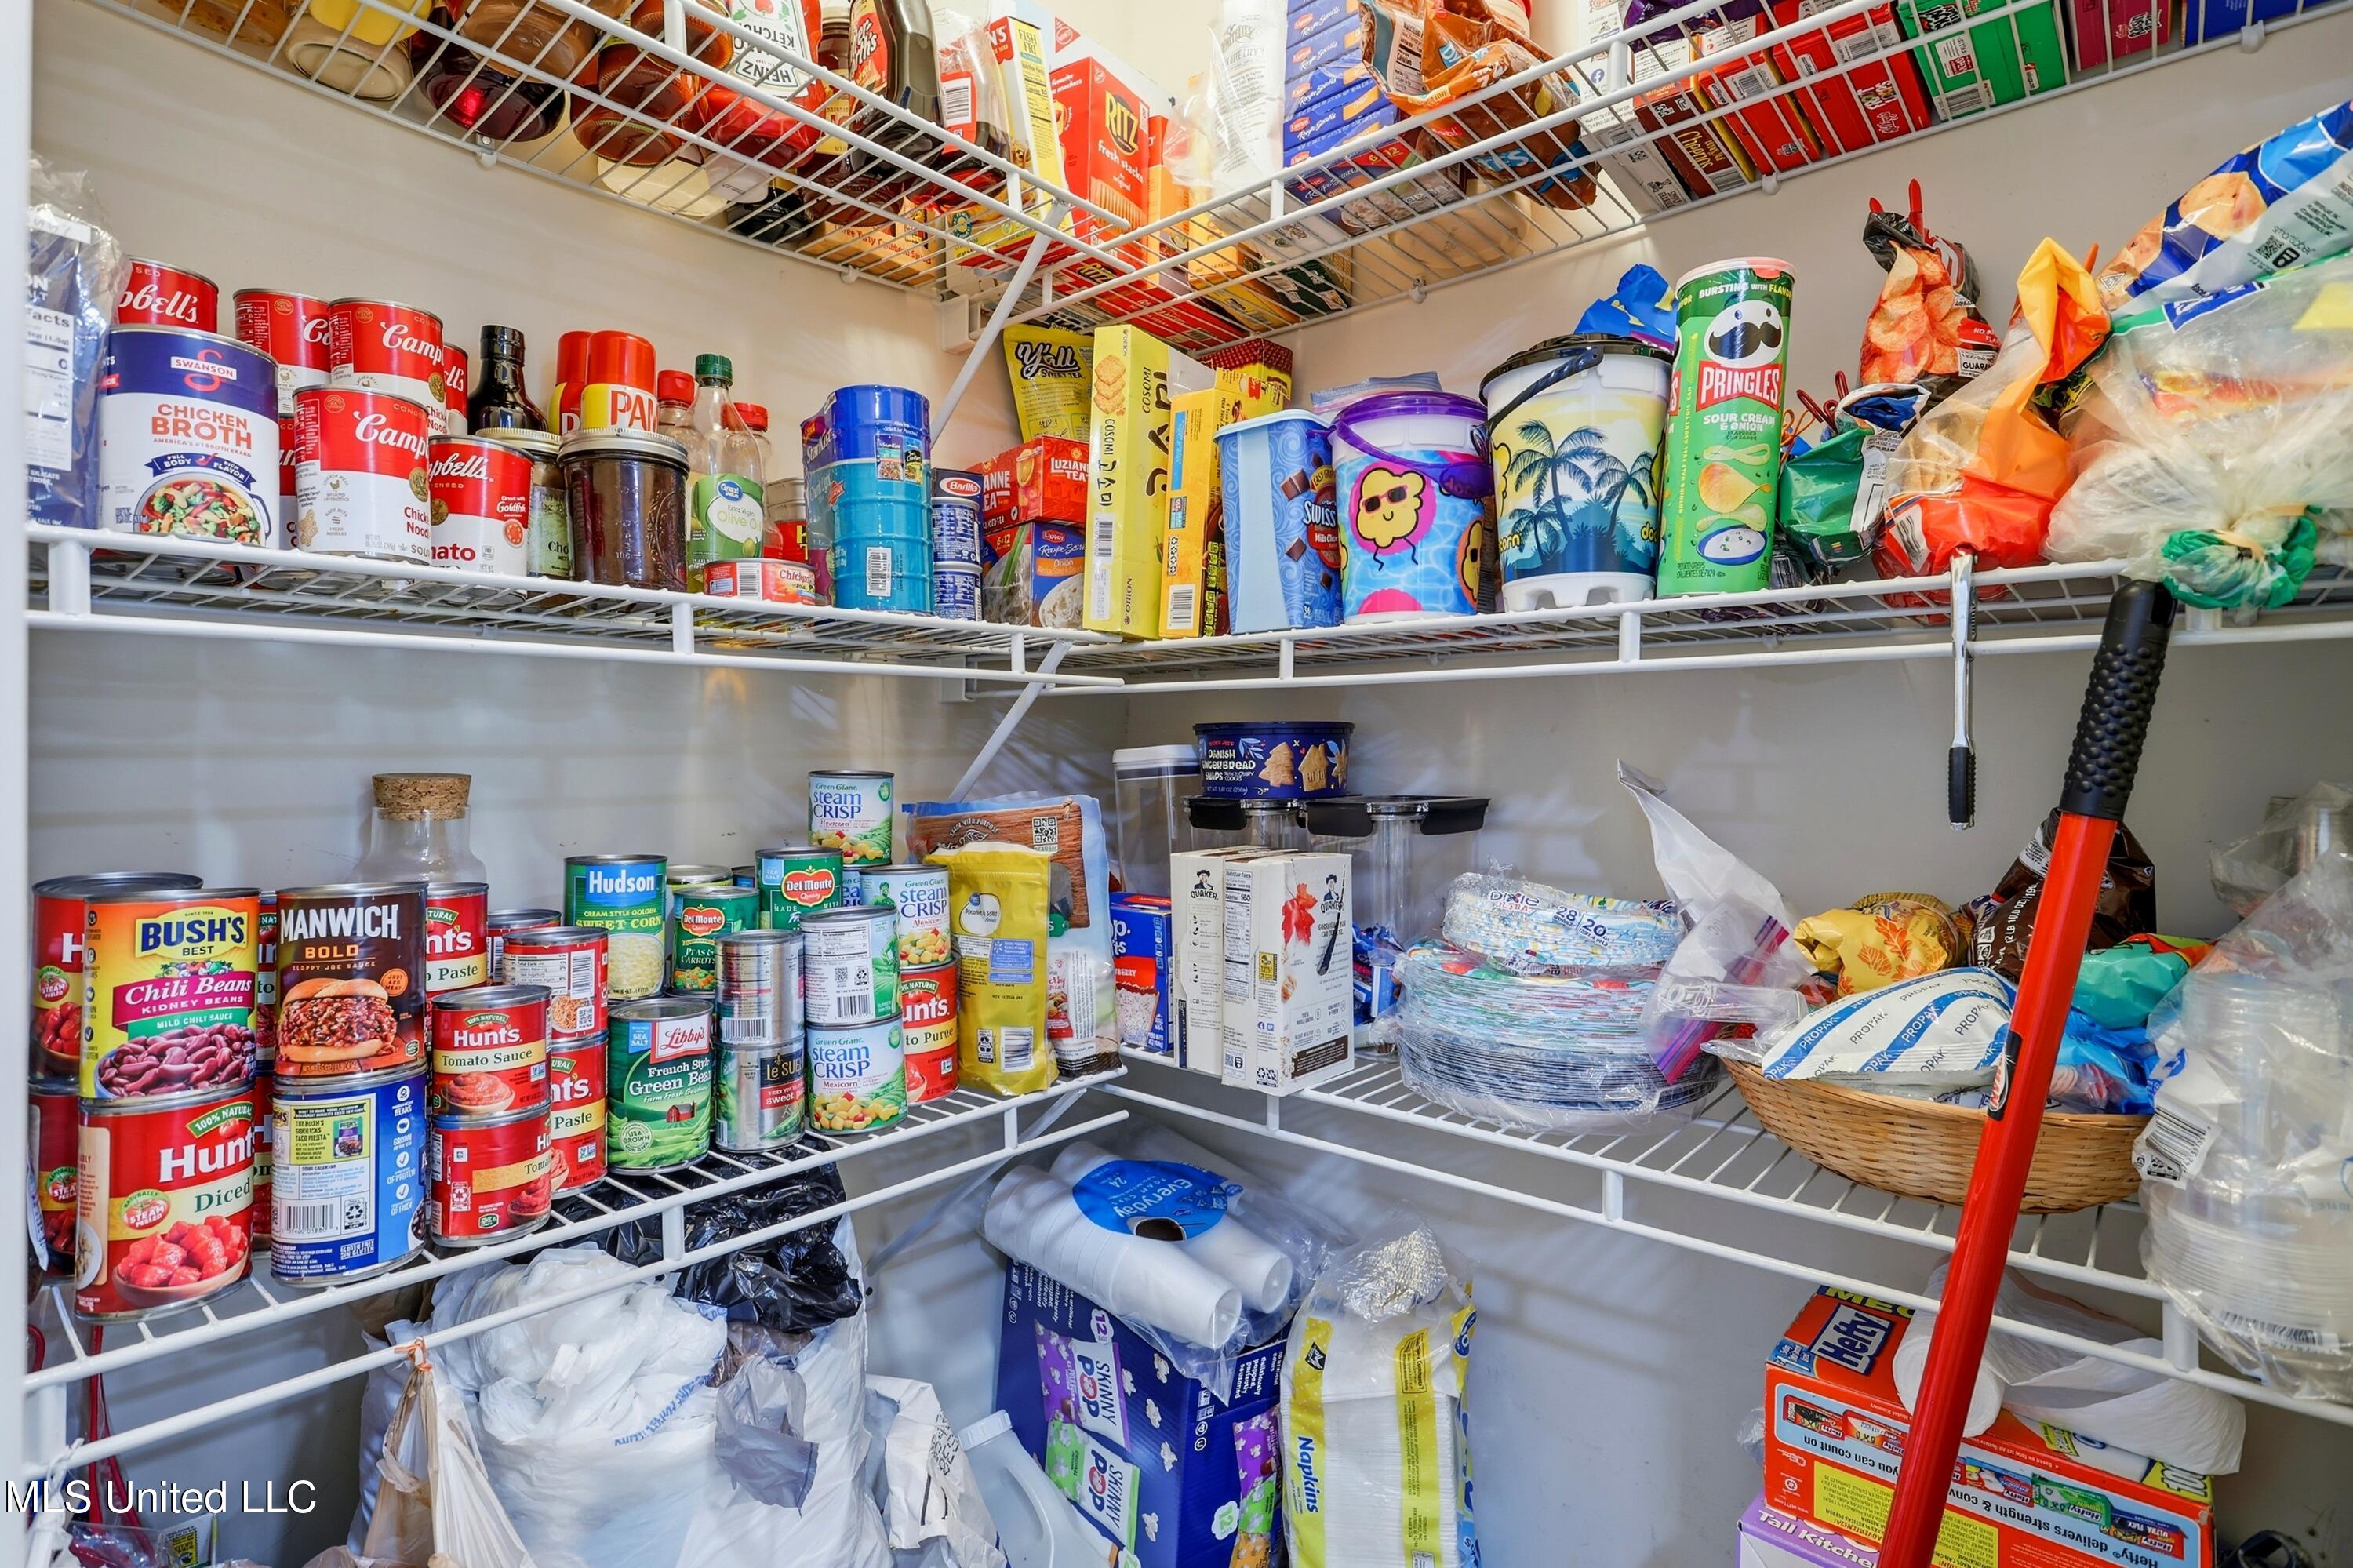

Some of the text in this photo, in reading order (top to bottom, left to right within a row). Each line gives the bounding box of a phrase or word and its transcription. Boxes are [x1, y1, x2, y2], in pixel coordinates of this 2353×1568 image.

[1019, 29, 1037, 45] FISH
[1024, 41, 1036, 55] FRI
[1105, 90, 1138, 155] RITZ
[1098, 142, 1144, 184] fresh stacks
[1699, 282, 1748, 299] BURSTING
[1020, 340, 1078, 377] Y'all
[175, 358, 234, 378] SWANSON
[1041, 369, 1067, 378] SWEET
[1142, 366, 1151, 414] COSOMI
[1700, 366, 1780, 405] PRINGLES
[157, 403, 248, 431] CHICKEN
[1703, 412, 1775, 425] SOUR CREAM
[151, 416, 252, 449] BROTH
[1729, 422, 1763, 432] ONION
[1104, 418, 1115, 456] COSOMI
[163, 457, 191, 468] BODY
[213, 461, 245, 481] FLAVOR
[950, 482, 979, 493] Barilla
[717, 511, 747, 527] Olive
[1304, 500, 1337, 526] SWISS
[1208, 749, 1235, 759] DANISH
[1202, 760, 1256, 769] GINGERBREAD
[1206, 772, 1223, 780] SNAPS
[813, 791, 861, 805] steam
[813, 804, 862, 818] CRISP
[589, 870, 655, 893] Hudson
[787, 879, 832, 890] Del Monte
[900, 887, 947, 904] steam
[1190, 890, 1217, 900] QUAKER
[901, 899, 947, 918] CRISP
[1555, 906, 1578, 922] 28
[280, 904, 398, 944] MANWICH
[576, 915, 662, 930] SWEET CORN
[684, 915, 722, 924] Del Monte
[1582, 919, 1607, 937] 20
[141, 915, 245, 952] BUSH'S
[182, 946, 214, 956] BEST
[305, 944, 359, 959] BOLD
[686, 948, 706, 956] PEAS
[438, 964, 478, 981] Paste
[125, 980, 188, 1005] Chili
[193, 977, 252, 995] Beans
[910, 982, 936, 991] NATURAL
[142, 996, 243, 1014] KIDNEY BEANS
[157, 1013, 233, 1029] MILD CHILI SAUCE
[480, 1014, 505, 1023] NATURAL
[1849, 1010, 1888, 1045] PROPAK
[1902, 1003, 1940, 1042] PROPAK
[454, 1027, 519, 1047] Hunt's
[660, 1026, 705, 1050] Libby's
[924, 1027, 954, 1044] Puree
[1800, 1015, 1839, 1049] PROPAK
[442, 1049, 532, 1067] Tomato Sauce
[813, 1046, 870, 1061] steam
[648, 1057, 710, 1078] French Style
[766, 1064, 779, 1080] Le
[813, 1061, 871, 1078] CRISP
[629, 1078, 682, 1096] Green
[823, 1080, 858, 1089] Mexicorn
[766, 1092, 795, 1104] sweet
[394, 1105, 413, 1116] BEANS
[194, 1113, 220, 1131] 100%
[555, 1111, 592, 1130] Paste
[624, 1135, 650, 1144] GROWN
[387, 1176, 395, 1184] OF
[1109, 1176, 1128, 1188] 24
[195, 1177, 250, 1213] Diced
[1114, 1179, 1192, 1218] Everyday
[129, 1203, 165, 1224] STEAM
[135, 1213, 164, 1229] PEELED
[1096, 1315, 1107, 1336] 12
[1818, 1312, 1883, 1366] Hefty
[1077, 1354, 1100, 1418] POP
[1804, 1435, 1900, 1477] you can count on
[1089, 1448, 1108, 1513] POP
[1297, 1435, 1318, 1514] Napkins
[1983, 1500, 1991, 1511] &
[2070, 1504, 2101, 1523] Hefty
[1219, 1504, 1235, 1527] 12
[1758, 1511, 1795, 1533] Tall
[1995, 1506, 2052, 1531] strength
[2054, 1526, 2108, 1553] delivers
[2142, 1536, 2172, 1553] Hefty
